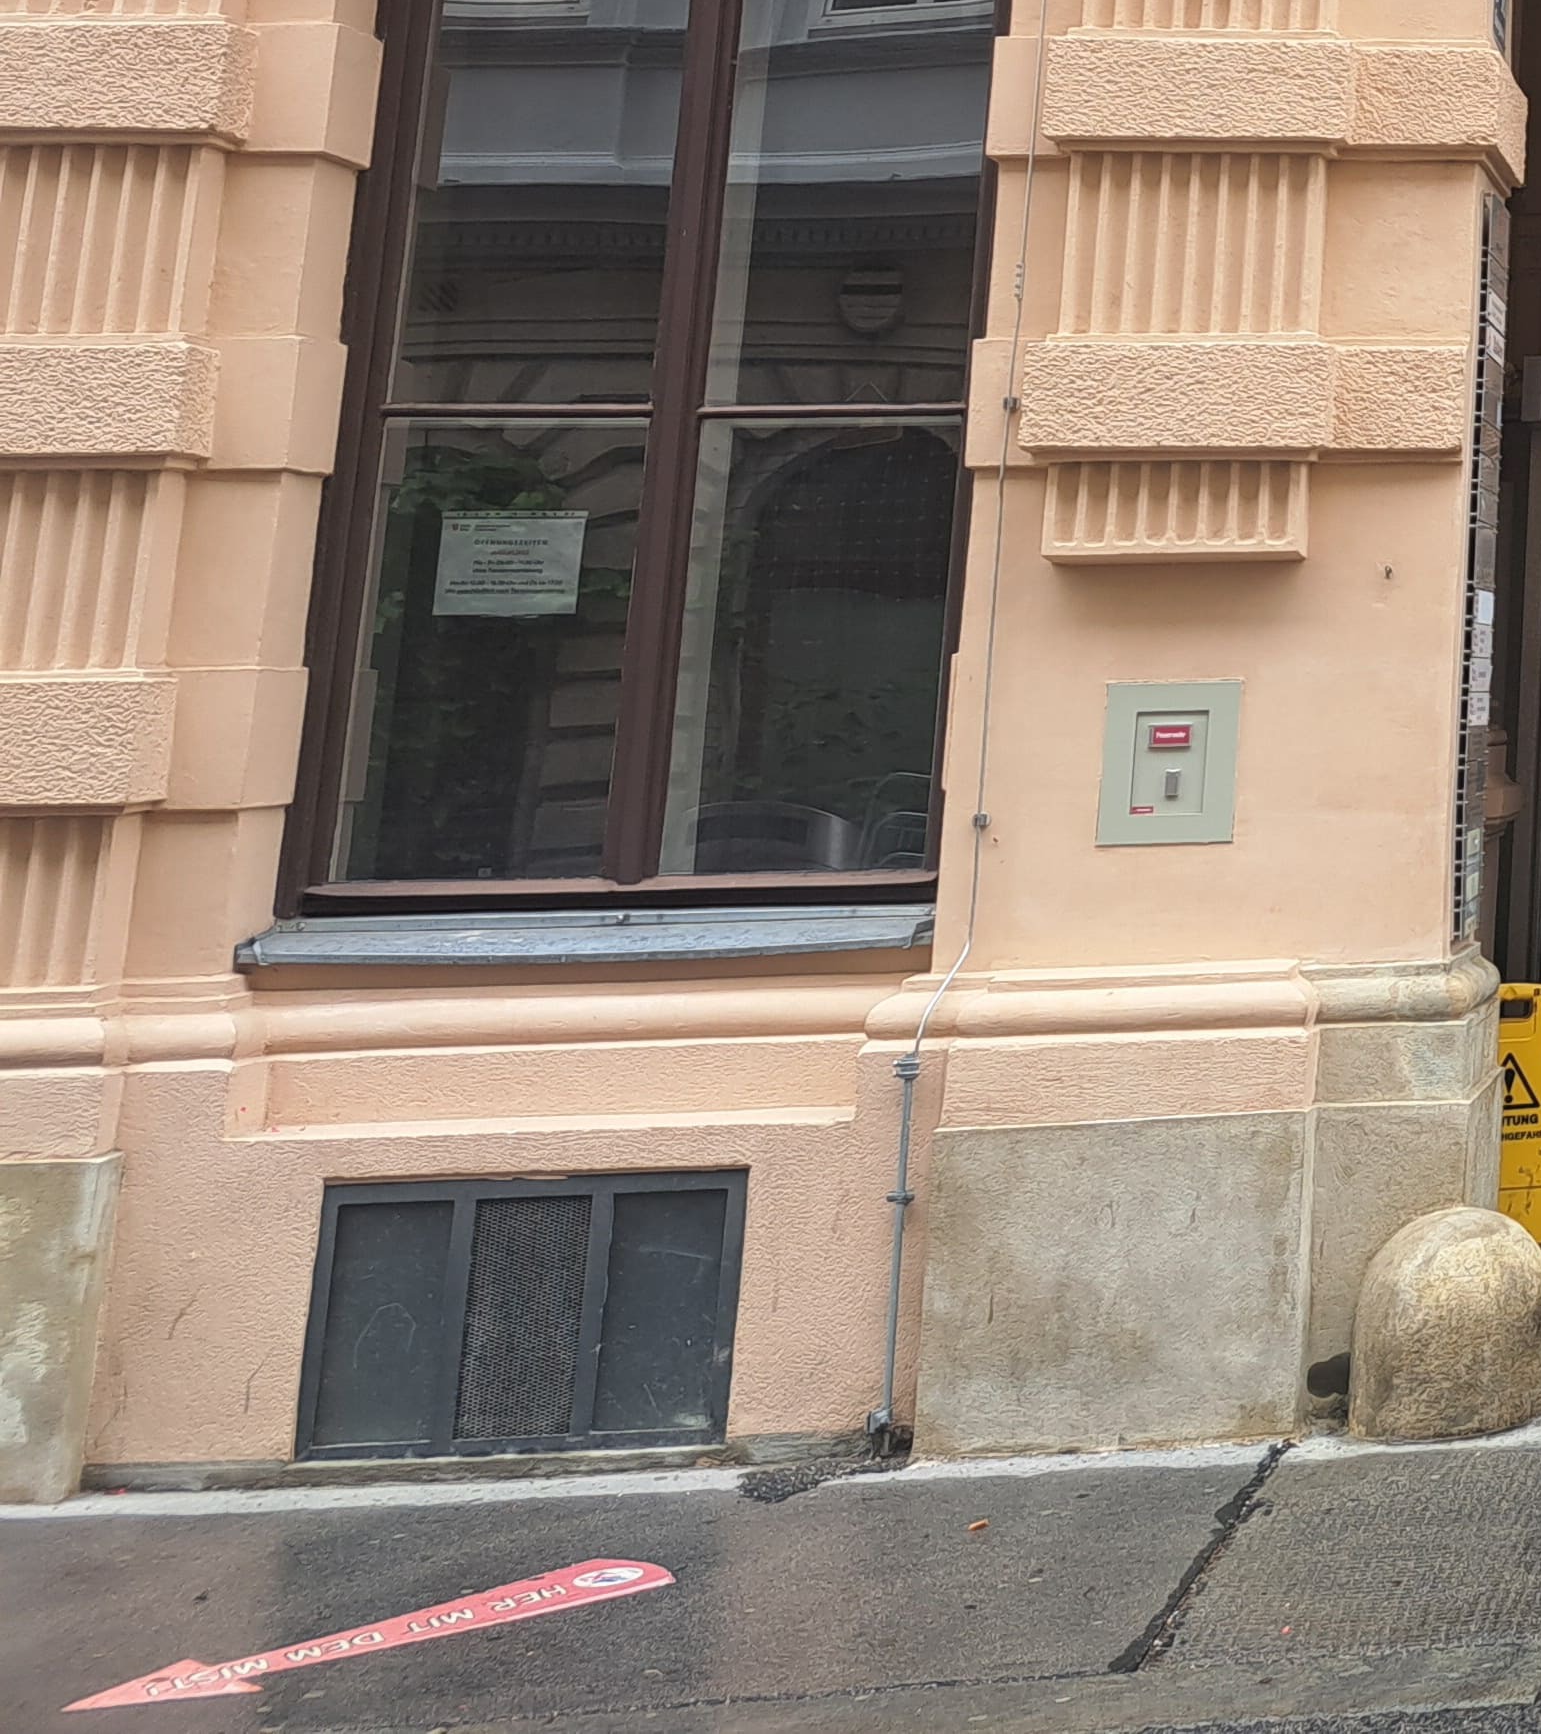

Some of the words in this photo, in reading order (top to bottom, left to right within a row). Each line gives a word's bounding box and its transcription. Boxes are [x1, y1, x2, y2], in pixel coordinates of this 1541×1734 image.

[491, 1583, 568, 1612] HER
[406, 1608, 476, 1637] MIT
[287, 1630, 386, 1663] DEM
